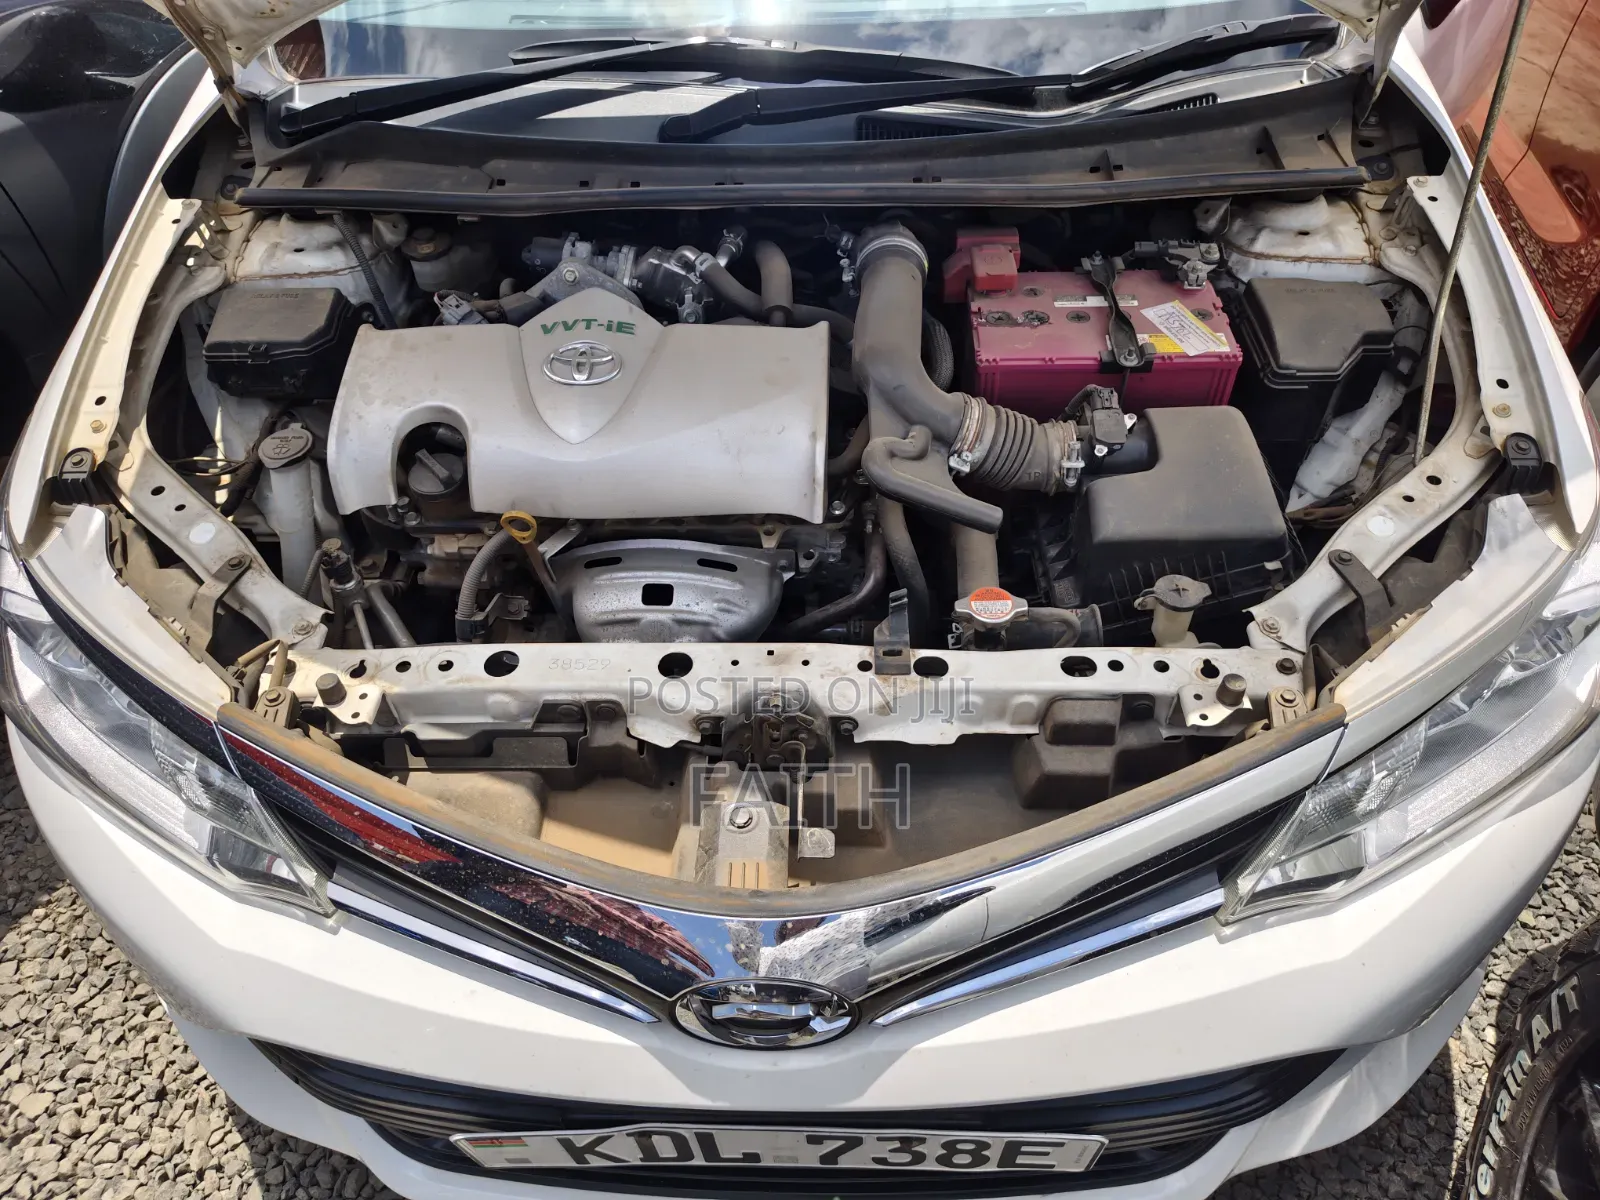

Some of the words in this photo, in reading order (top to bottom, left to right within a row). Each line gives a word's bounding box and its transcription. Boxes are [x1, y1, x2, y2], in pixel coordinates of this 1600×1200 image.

[540, 318, 637, 336] VVT-iE
[548, 657, 612, 671] 38529
[1469, 1049, 1532, 1200] errain
[1531, 975, 1580, 1054] A/T
[555, 1130, 763, 1165] KDL
[804, 1134, 1067, 1170] 738E
